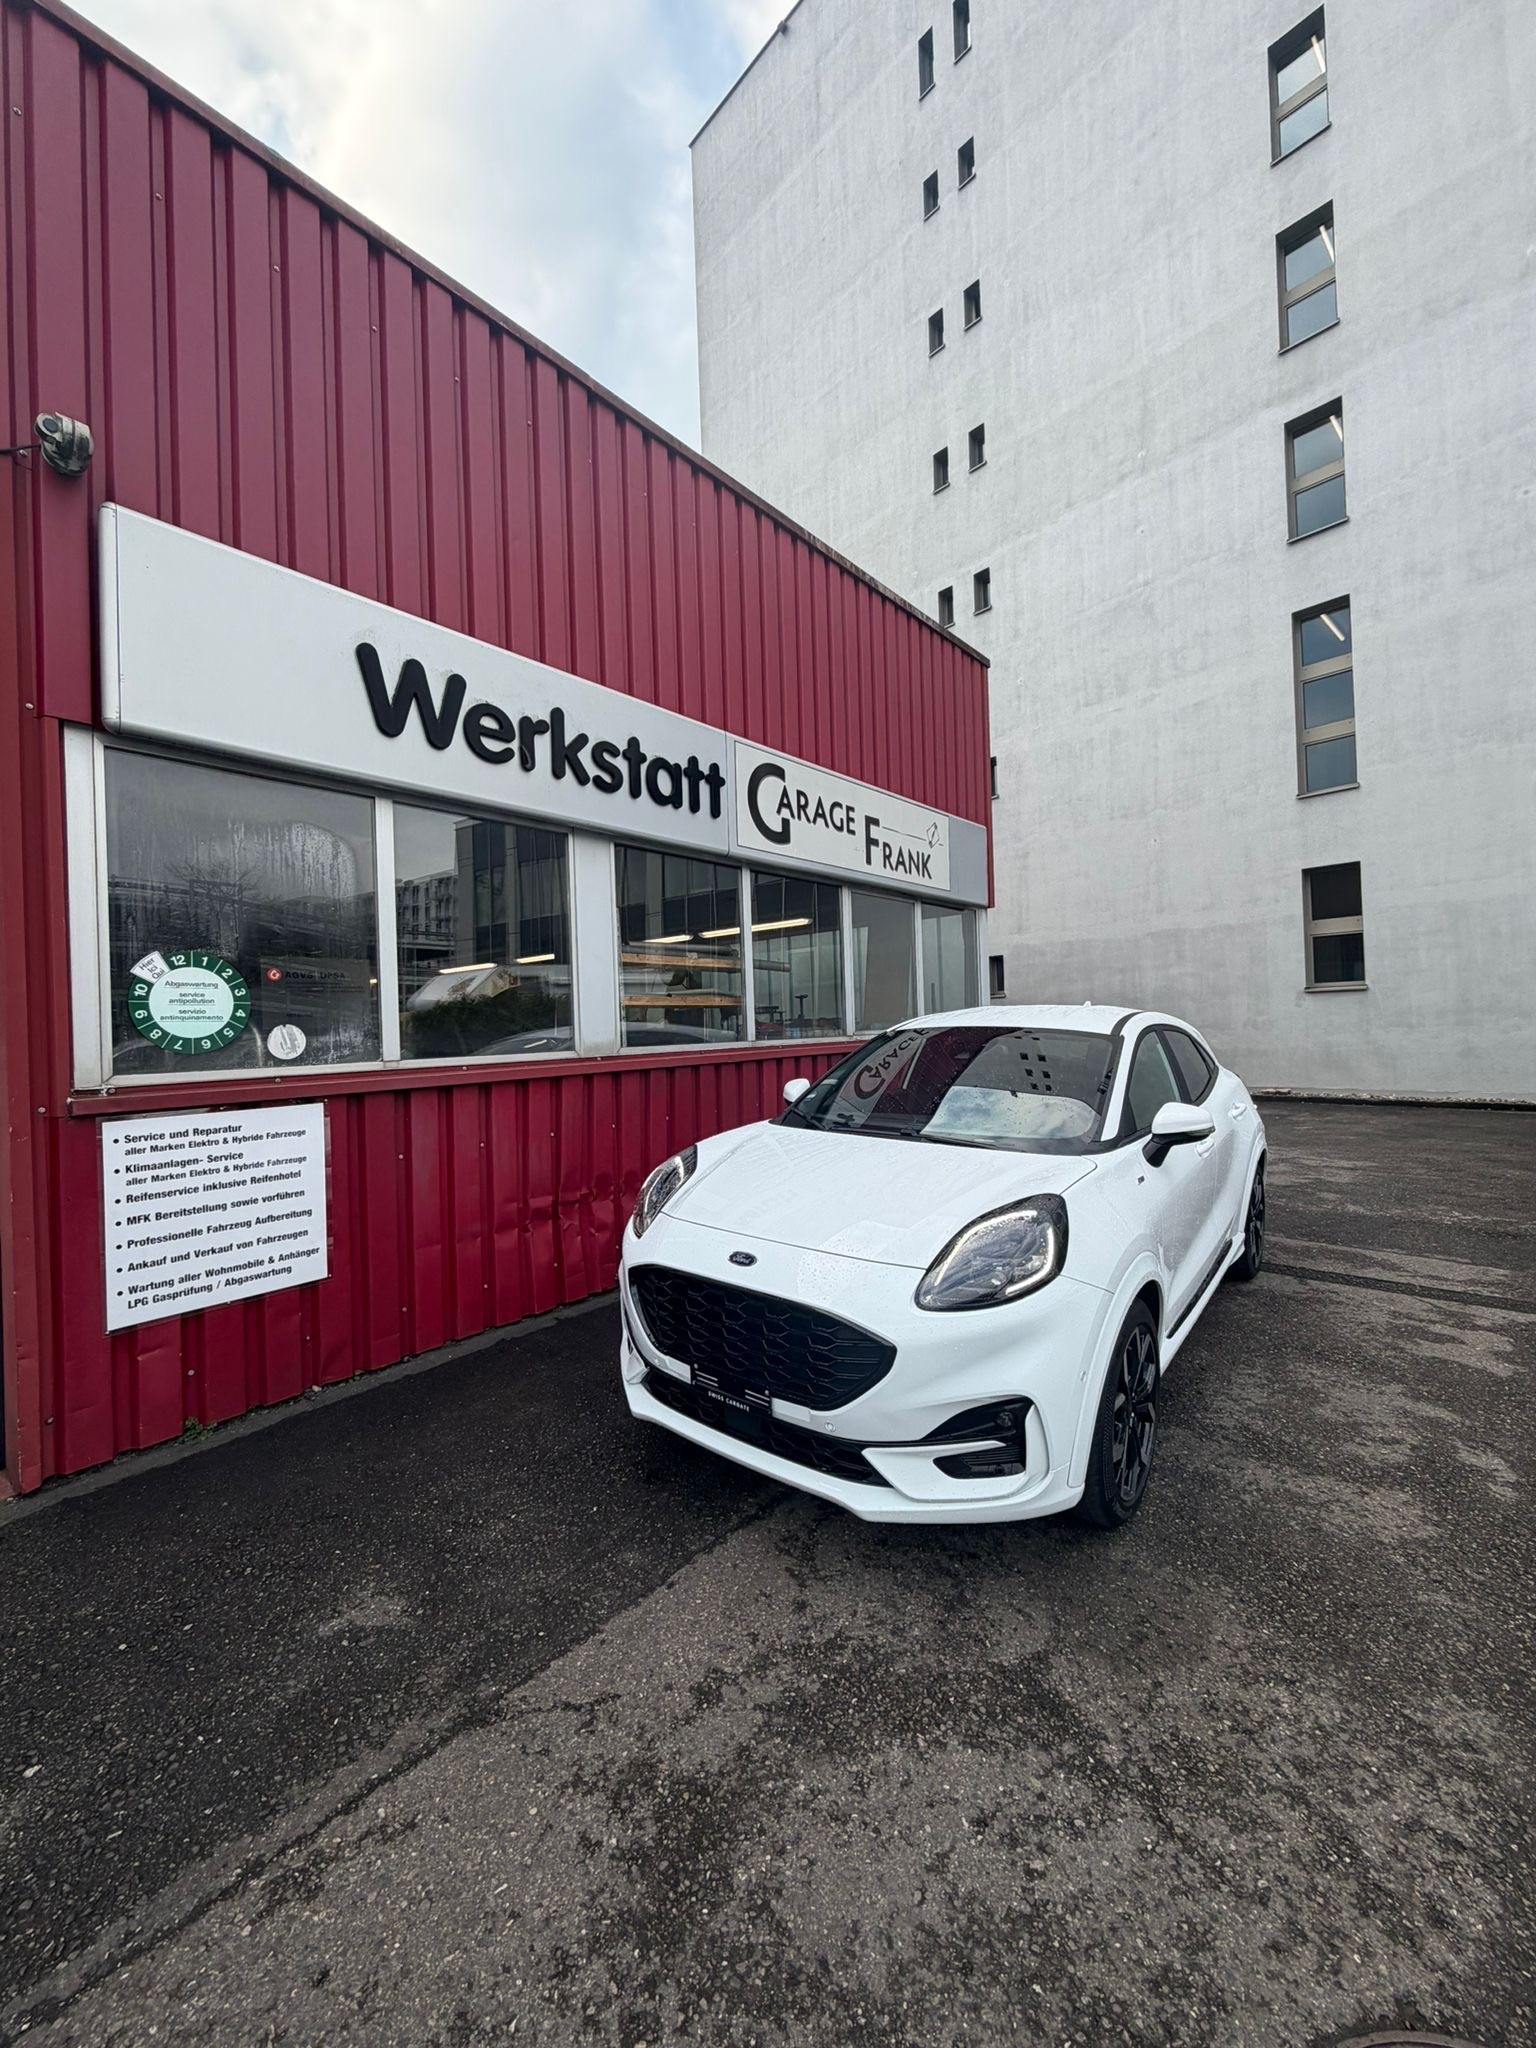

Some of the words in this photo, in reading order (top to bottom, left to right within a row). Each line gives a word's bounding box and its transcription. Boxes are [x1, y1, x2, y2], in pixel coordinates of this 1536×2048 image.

[355, 641, 726, 820] Werkstatt
[747, 762, 856, 845] GARAGE
[864, 815, 933, 880] FRANK
[139, 957, 155, 970] Hier
[171, 955, 186, 966] 12
[201, 956, 208, 966] 1
[147, 965, 158, 973] Ici
[152, 969, 165, 979] Qui
[221, 969, 232, 979] 2
[134, 984, 148, 996] 10
[235, 988, 246, 996] 3
[135, 1010, 147, 1018] 9
[235, 1009, 246, 1017] 4
[150, 1029, 162, 1039] 8
[223, 1028, 234, 1037] 5
[174, 1040, 183, 1050] 7
[201, 1039, 211, 1049] 6
[124, 1133, 165, 1144] Service
[169, 1130, 189, 1139] und
[193, 1124, 242, 1137] Reparatur
[125, 1146, 146, 1156] aller
[150, 1142, 185, 1152] Marken
[189, 1138, 219, 1149] Elektro
[232, 1133, 263, 1144] Hybride
[266, 1129, 306, 1140] Fahrzeuge
[125, 1156, 203, 1174] Klimaanlagen-
[207, 1152, 243, 1163] Service
[126, 1176, 148, 1186] aller
[151, 1172, 186, 1183] Marken
[190, 1166, 220, 1177] Elektro
[233, 1160, 264, 1172] Hybride
[267, 1155, 307, 1167] Fahrzeuge
[127, 1184, 199, 1203] Reifenservice
[203, 1178, 247, 1192] inklusive
[251, 1170, 301, 1184] Reifenhotel
[127, 1215, 151, 1226] MFK
[155, 1201, 227, 1221] Bereitstellung
[231, 1197, 258, 1209] sowie
[262, 1189, 305, 1203] vorführen
[127, 1228, 203, 1249] Professionelle
[207, 1219, 252, 1235] Fahrzeug
[255, 1208, 312, 1225] Aufbereitung
[128, 1256, 166, 1272] Ankauf
[171, 1252, 190, 1263] und
[194, 1244, 233, 1258] Verkauf
[236, 1240, 253, 1250] von
[257, 1228, 308, 1246] Fahrzeugen
[733, 1254, 751, 1264] Ford
[128, 1278, 174, 1294] Wartung
[178, 1272, 201, 1283] aller
[205, 1260, 265, 1278] Wohnmobile
[278, 1245, 319, 1262] Anhänger
[128, 1297, 148, 1309] LPG
[153, 1281, 213, 1304] Gasprüfung
[217, 1281, 220, 1289] /
[224, 1265, 292, 1287] Abgaswartung
[708, 1390, 724, 1402] SWISS
[726, 1398, 749, 1412] CARGATE
